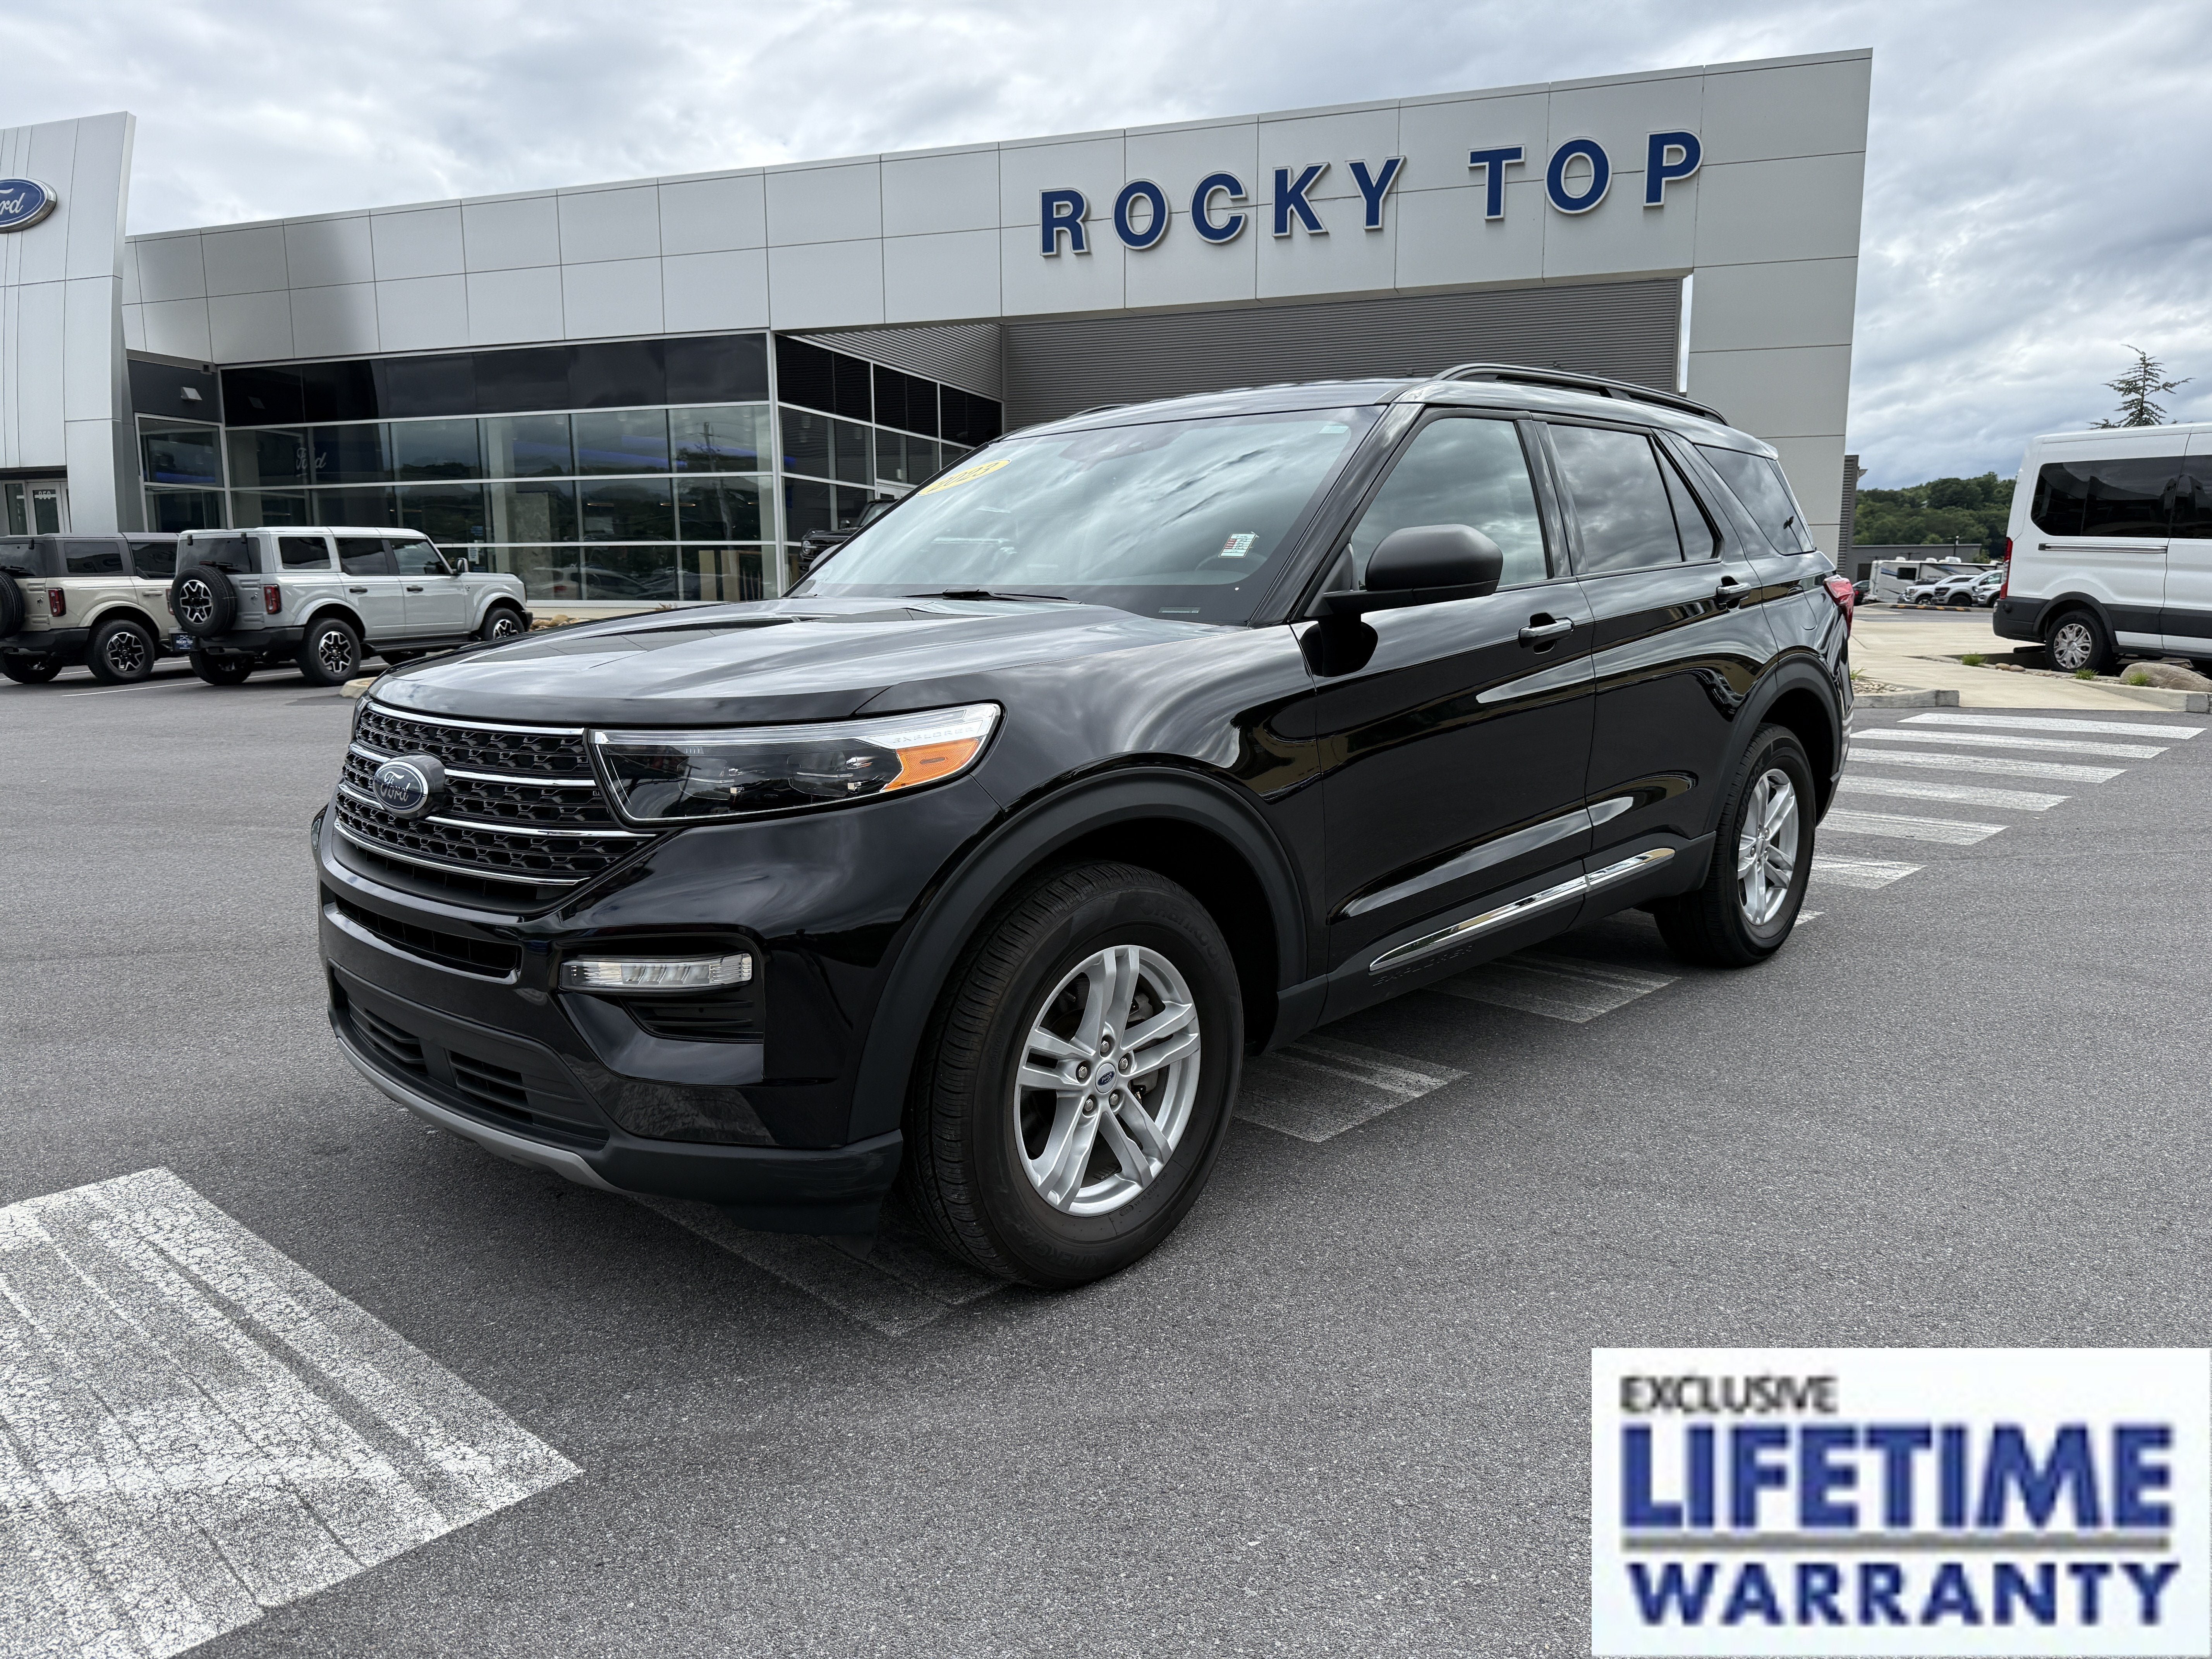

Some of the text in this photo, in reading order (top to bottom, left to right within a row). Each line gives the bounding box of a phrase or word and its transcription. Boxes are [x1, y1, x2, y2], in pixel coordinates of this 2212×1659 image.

[0, 188, 26, 215] rd
[1039, 129, 1704, 256] ROCKY TOP
[296, 447, 327, 470] Fod
[926, 462, 1000, 493] 2023
[892, 727, 974, 743] EXPLORER
[381, 771, 411, 802] Ford
[1372, 945, 1474, 987] EXPLORER
